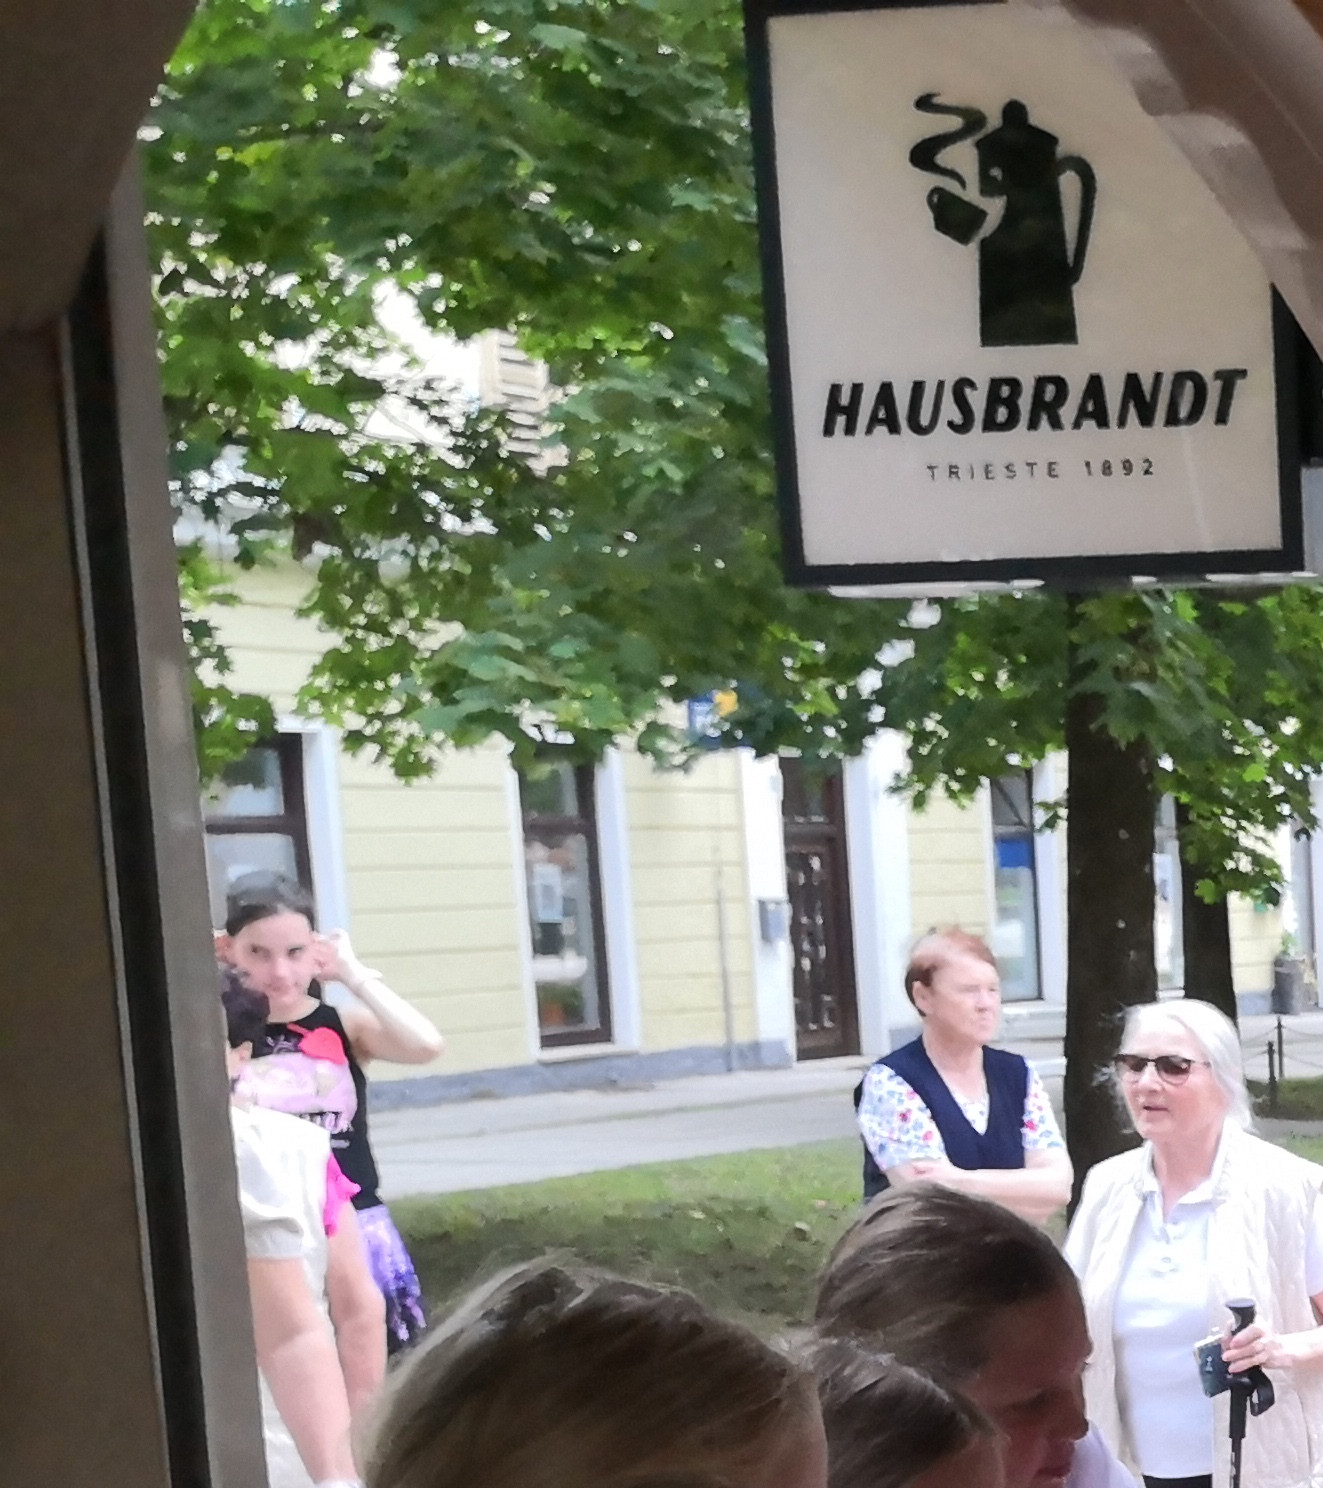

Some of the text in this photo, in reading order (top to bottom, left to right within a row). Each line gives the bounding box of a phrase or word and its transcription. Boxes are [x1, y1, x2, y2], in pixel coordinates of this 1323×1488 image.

[823, 369, 1248, 437] HAUSBRANDT
[926, 458, 1156, 482] TRIESTE 1892
